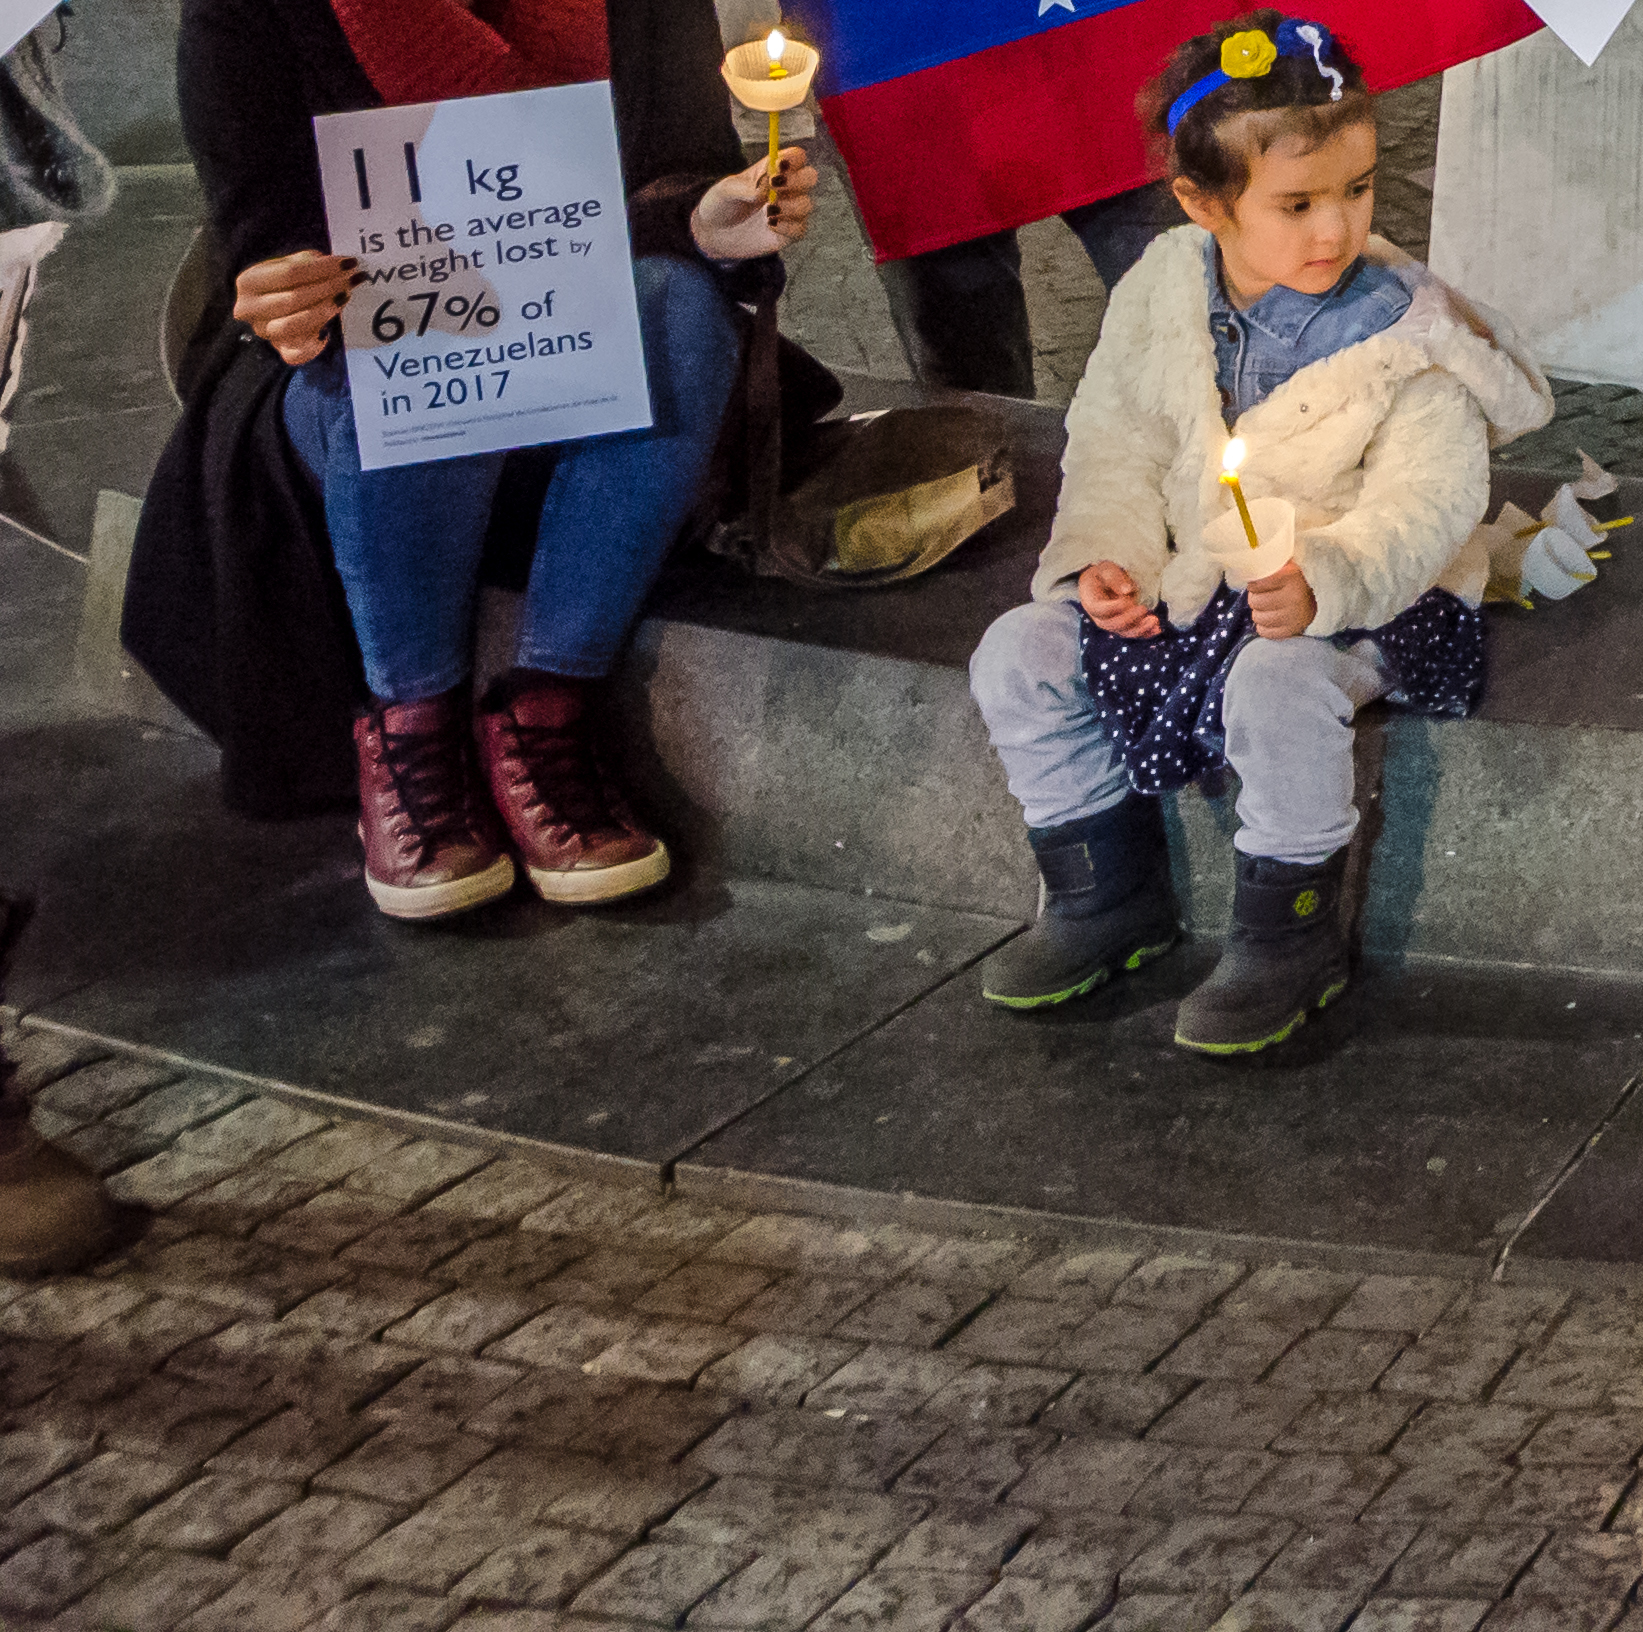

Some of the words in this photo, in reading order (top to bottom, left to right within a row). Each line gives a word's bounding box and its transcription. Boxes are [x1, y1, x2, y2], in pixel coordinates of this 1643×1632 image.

[465, 158, 524, 201] kg
[358, 228, 385, 254] is
[396, 219, 456, 250] the
[466, 198, 603, 240] average
[363, 247, 486, 286] weight
[495, 236, 560, 266] lost
[569, 239, 594, 258] by
[371, 291, 500, 344] 67%
[520, 289, 557, 322] of
[373, 329, 594, 382] Venezuelans
[380, 389, 413, 417] in
[422, 370, 511, 410] 2017
